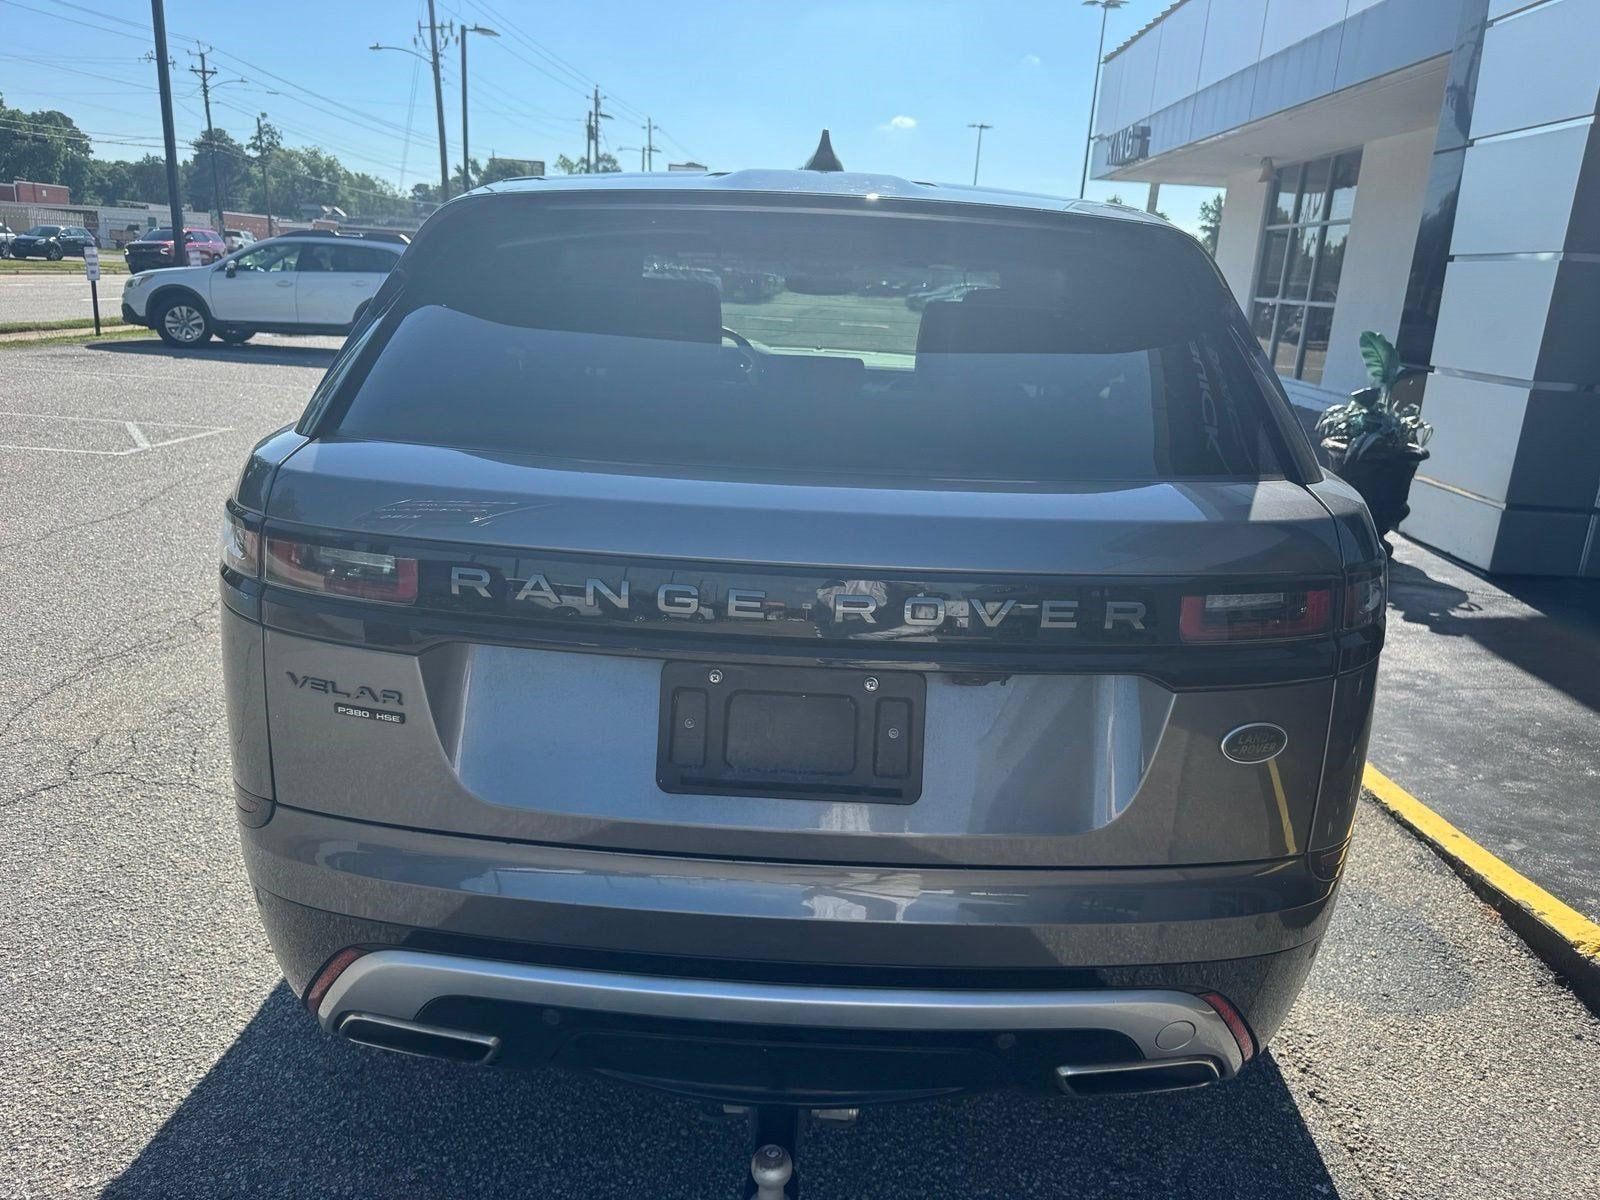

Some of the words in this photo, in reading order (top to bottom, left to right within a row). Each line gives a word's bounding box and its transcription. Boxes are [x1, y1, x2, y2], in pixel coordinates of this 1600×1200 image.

[450, 567, 767, 619] RANGE
[833, 594, 1146, 630] ROVER
[286, 671, 404, 705] VELAR
[337, 706, 370, 718] P380
[376, 712, 401, 723] HSE
[1239, 742, 1277, 755] ROVER
